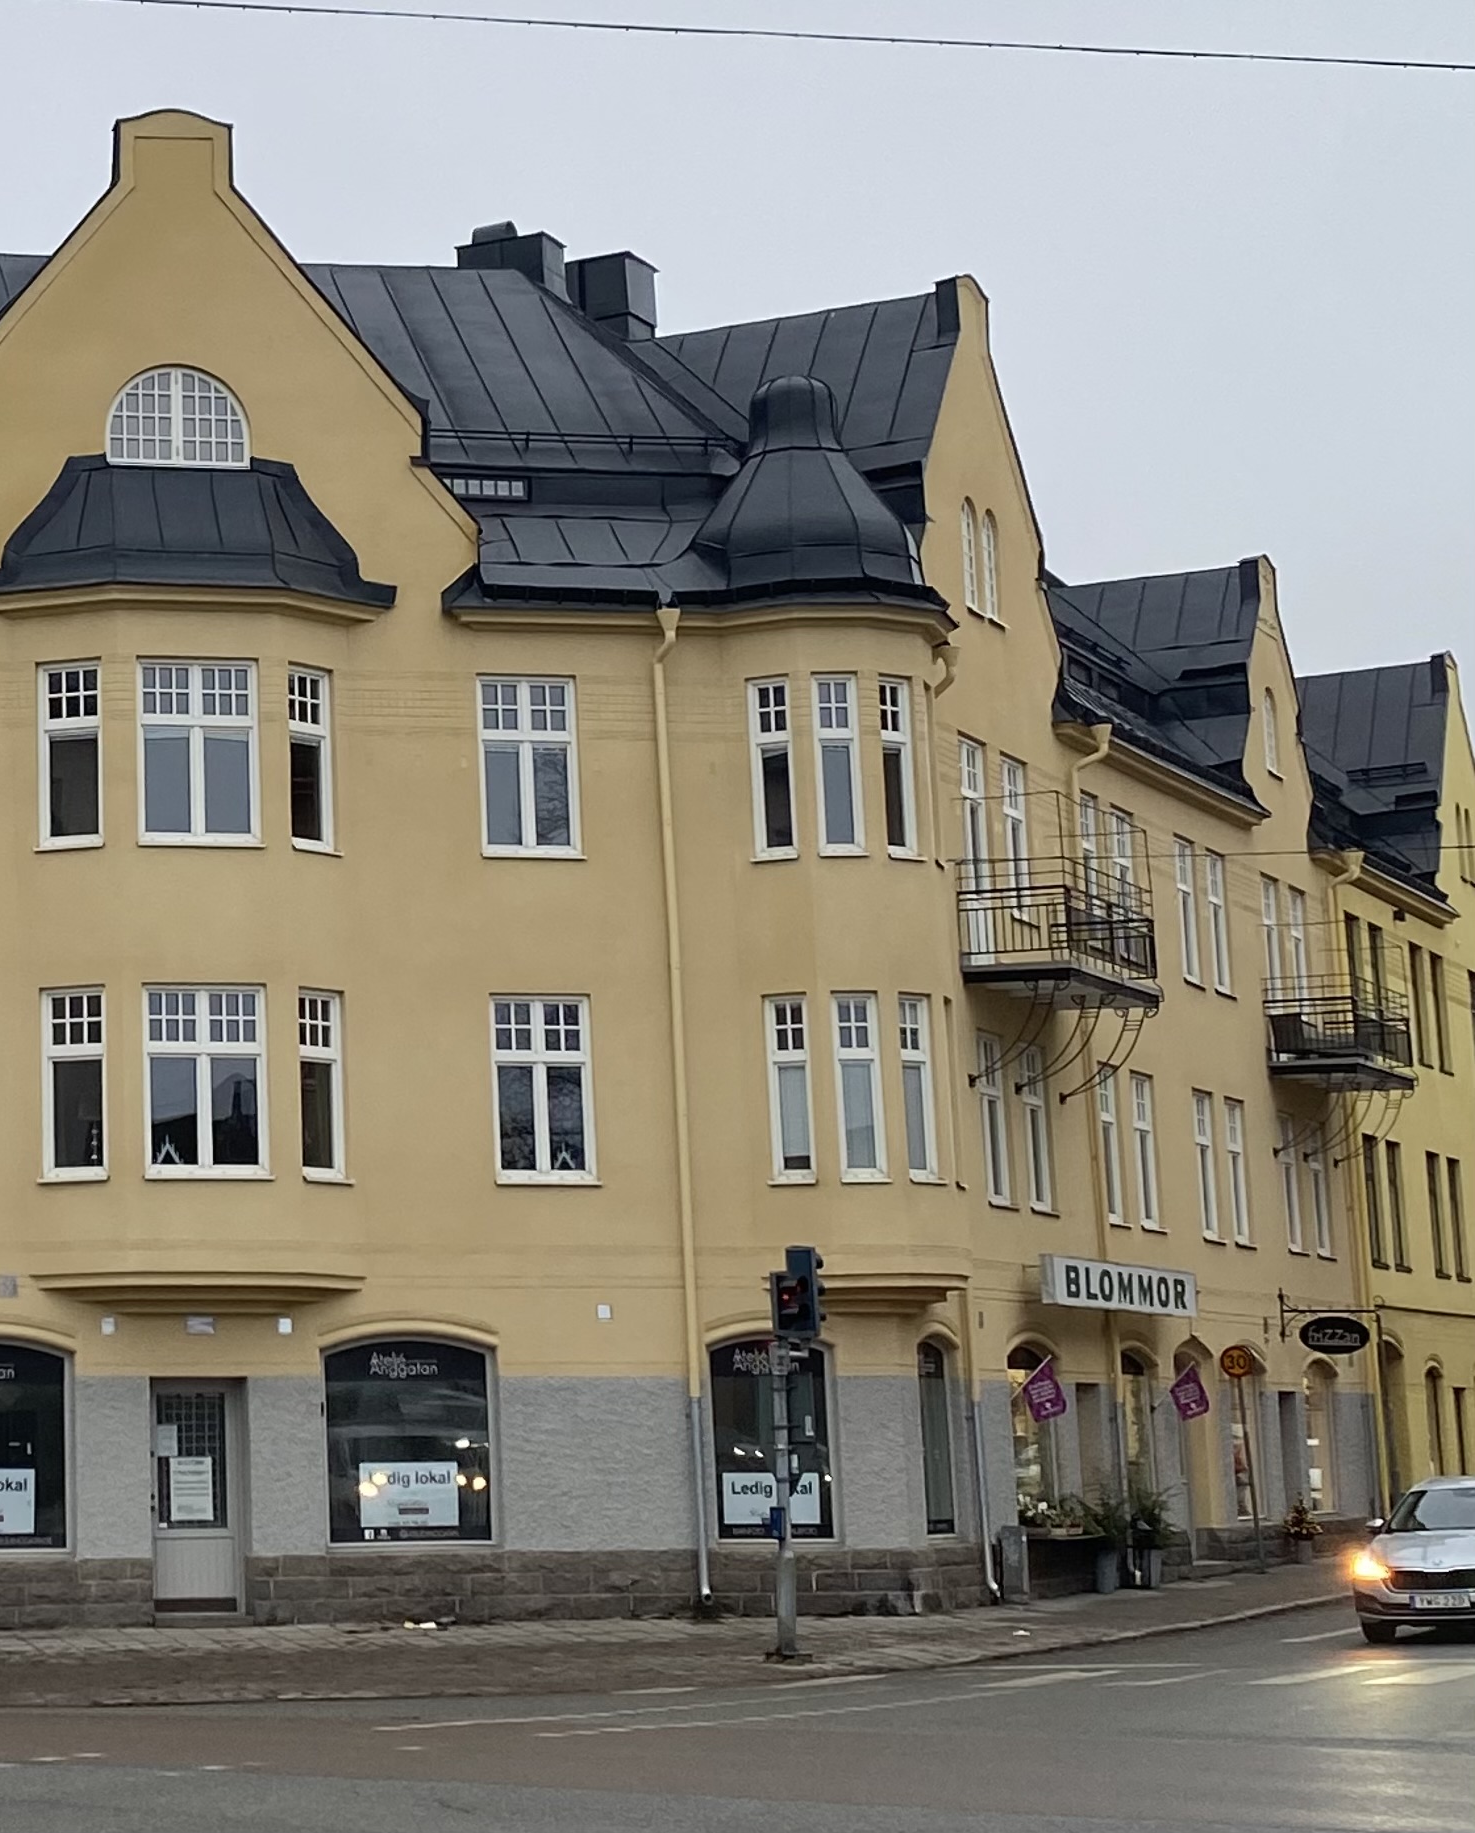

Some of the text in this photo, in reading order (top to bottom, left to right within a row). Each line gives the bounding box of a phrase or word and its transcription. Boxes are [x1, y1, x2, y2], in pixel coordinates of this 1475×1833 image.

[1065, 1264, 1187, 1310] BLOMMOR
[1225, 1354, 1246, 1370] 30
[369, 1471, 451, 1488] dig lokal
[731, 1481, 773, 1499] Ledig
